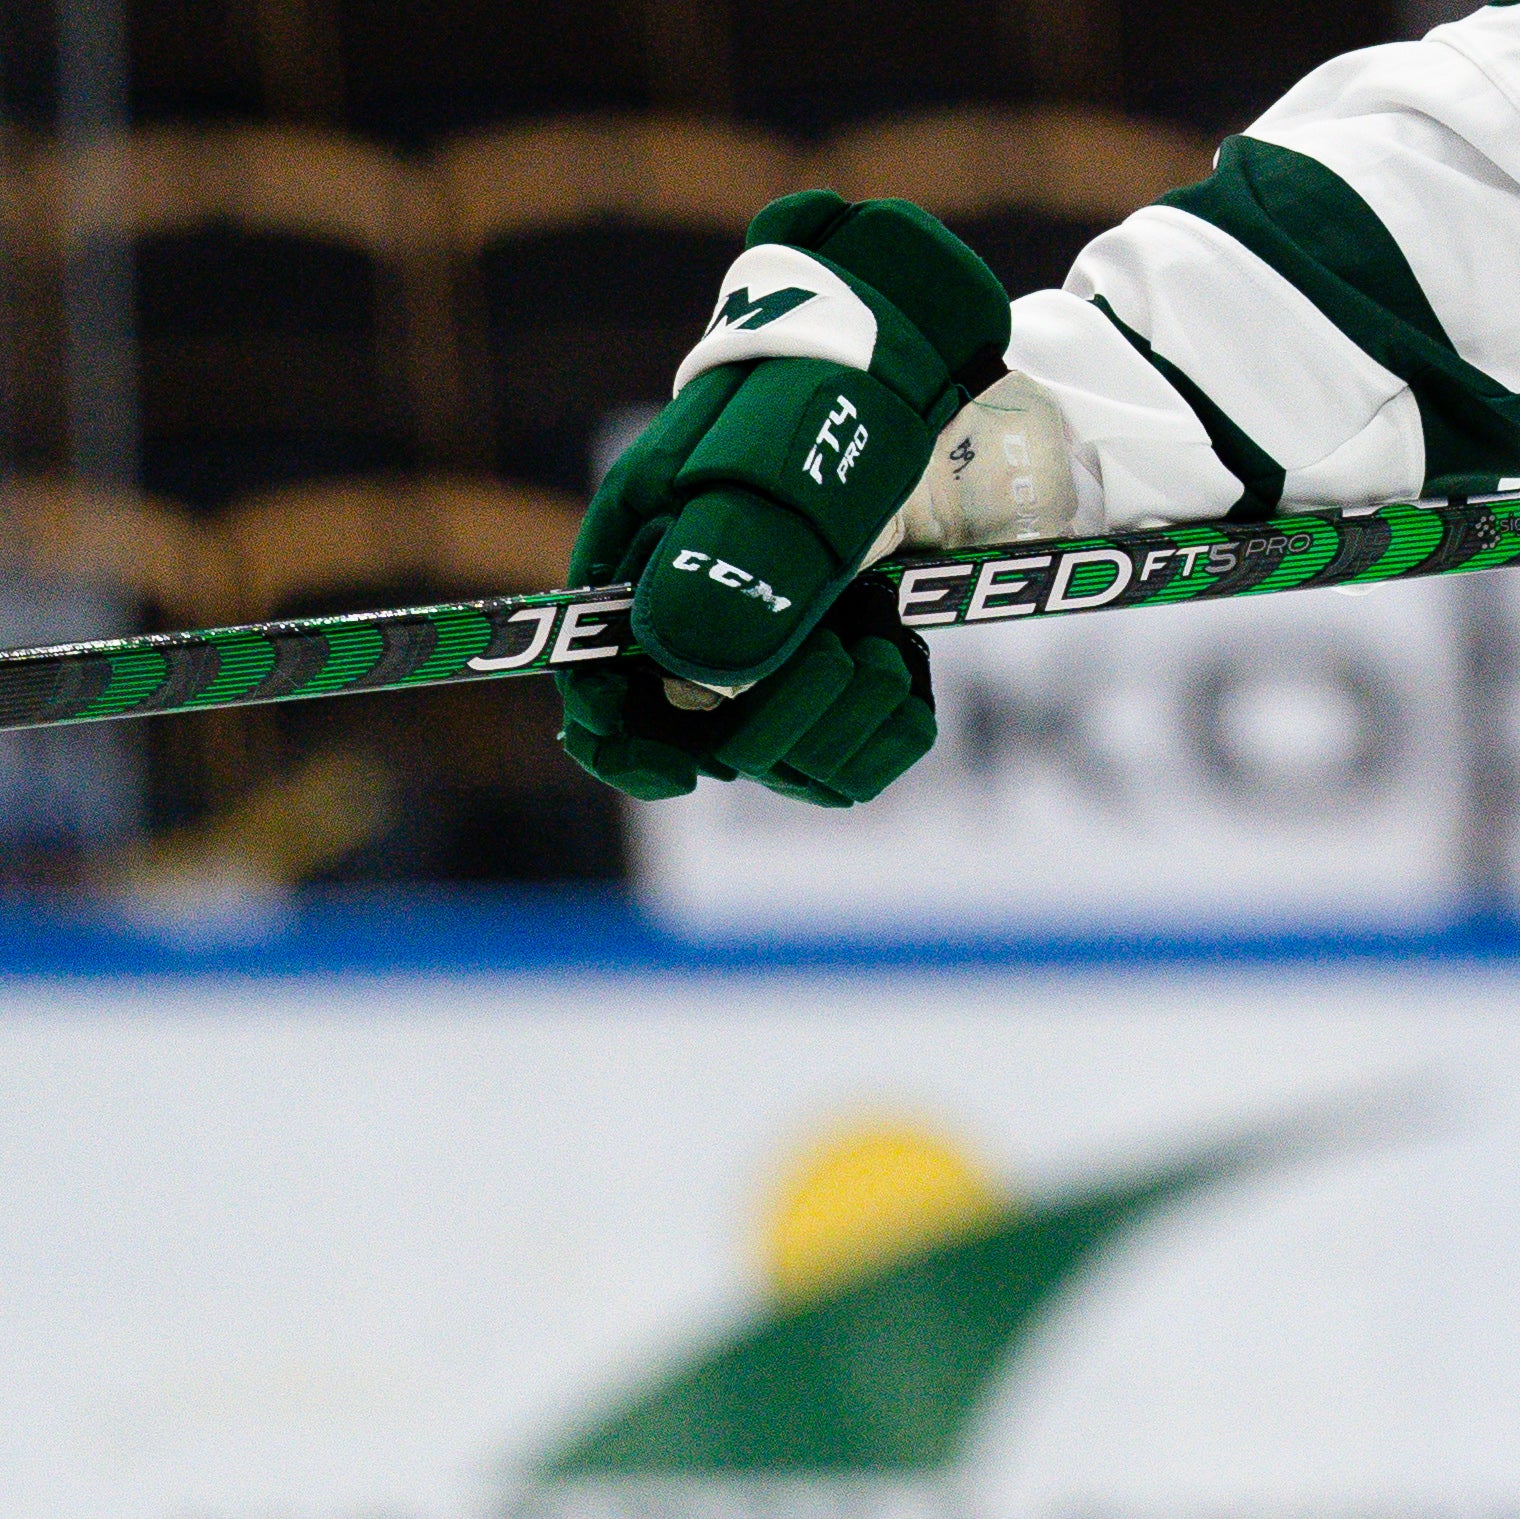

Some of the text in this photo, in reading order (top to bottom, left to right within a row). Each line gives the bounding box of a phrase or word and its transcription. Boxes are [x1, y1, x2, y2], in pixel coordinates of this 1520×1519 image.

[836, 422, 869, 485] PRO
[672, 548, 793, 614] CCM
[1140, 541, 1241, 582] FT5
[1244, 533, 1312, 557] PRO
